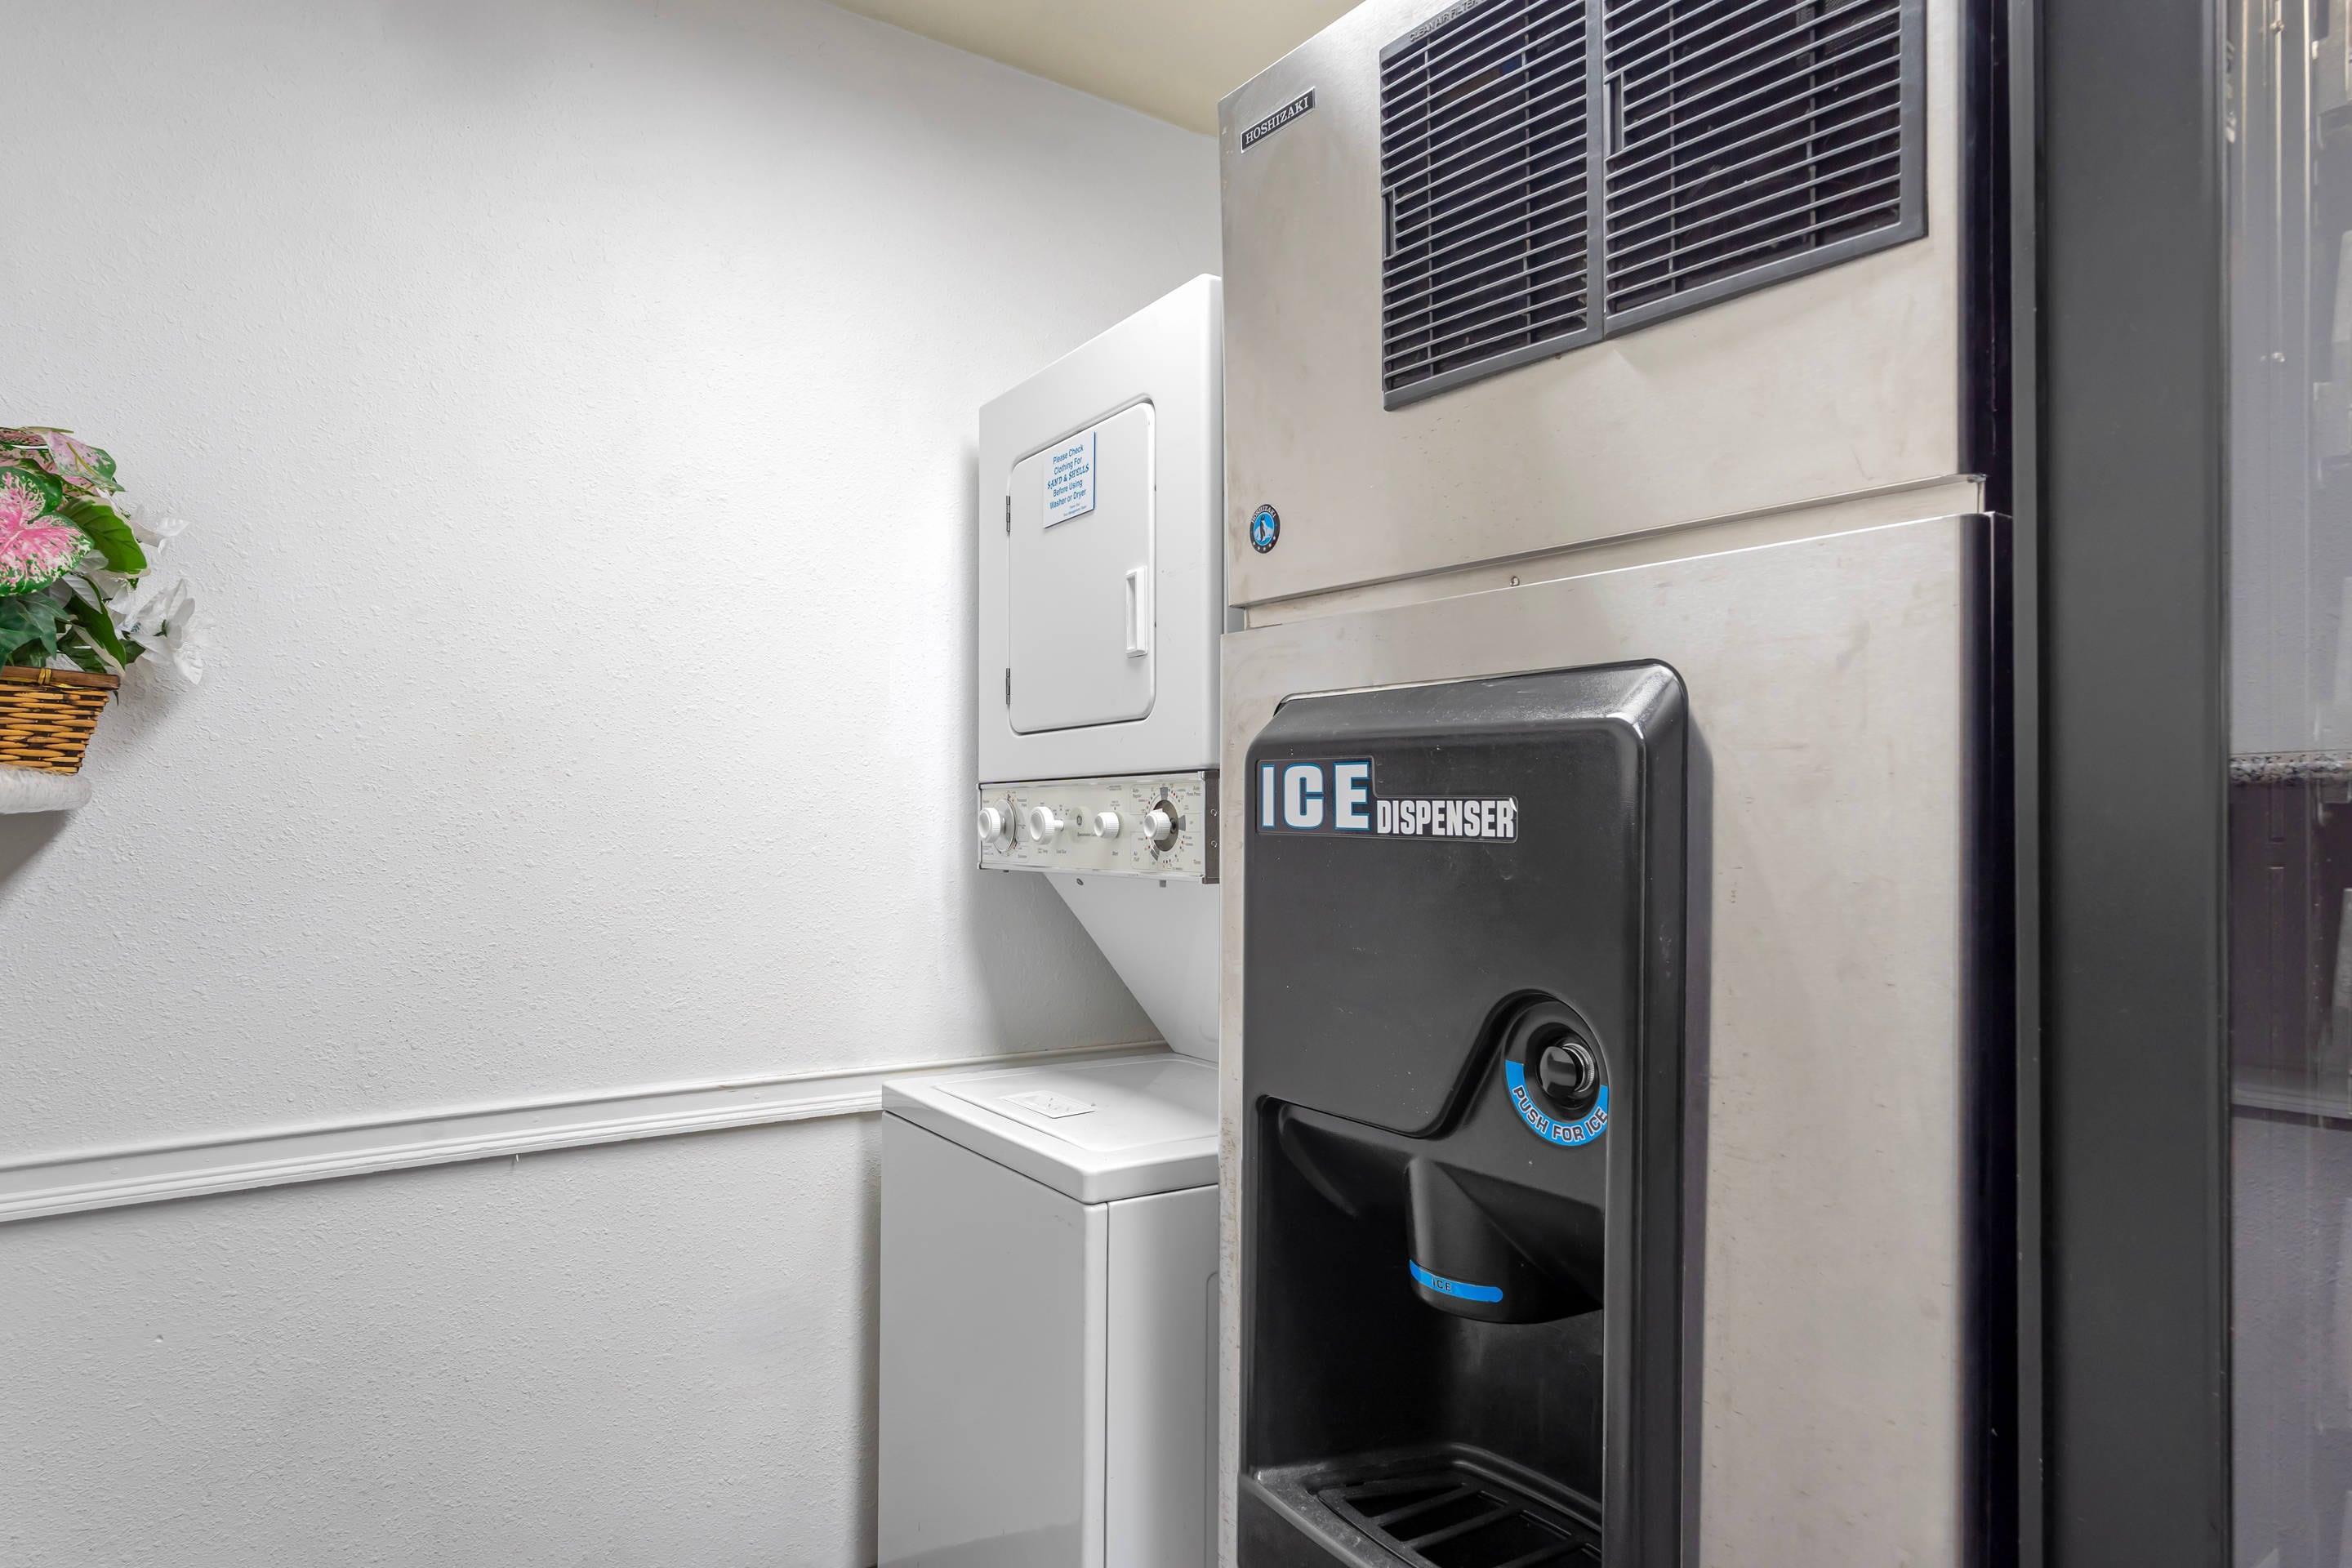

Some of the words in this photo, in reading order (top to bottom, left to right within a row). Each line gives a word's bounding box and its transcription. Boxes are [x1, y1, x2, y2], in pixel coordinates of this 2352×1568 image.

[1245, 96, 1308, 145] HOSHIZAKI
[1053, 453, 1067, 465] Please
[1068, 444, 1084, 457] Check
[1047, 476, 1062, 490] SAND
[1063, 474, 1067, 483] &
[1068, 463, 1089, 480] SHELLS
[1054, 461, 1073, 475] Clothing
[1074, 457, 1082, 466] For
[1053, 485, 1068, 497] Before
[1069, 479, 1083, 491] Using
[1049, 497, 1067, 510] Washer
[1067, 495, 1072, 503] or
[1073, 489, 1086, 501] Dryer
[1262, 760, 1372, 831] ICE
[1377, 800, 1516, 838] DISPENSER
[1512, 1085, 1549, 1134] PUSH
[1551, 1124, 1585, 1143] FOR
[1584, 1107, 1607, 1136] ICE
[1432, 1278, 1451, 1292] ICE
